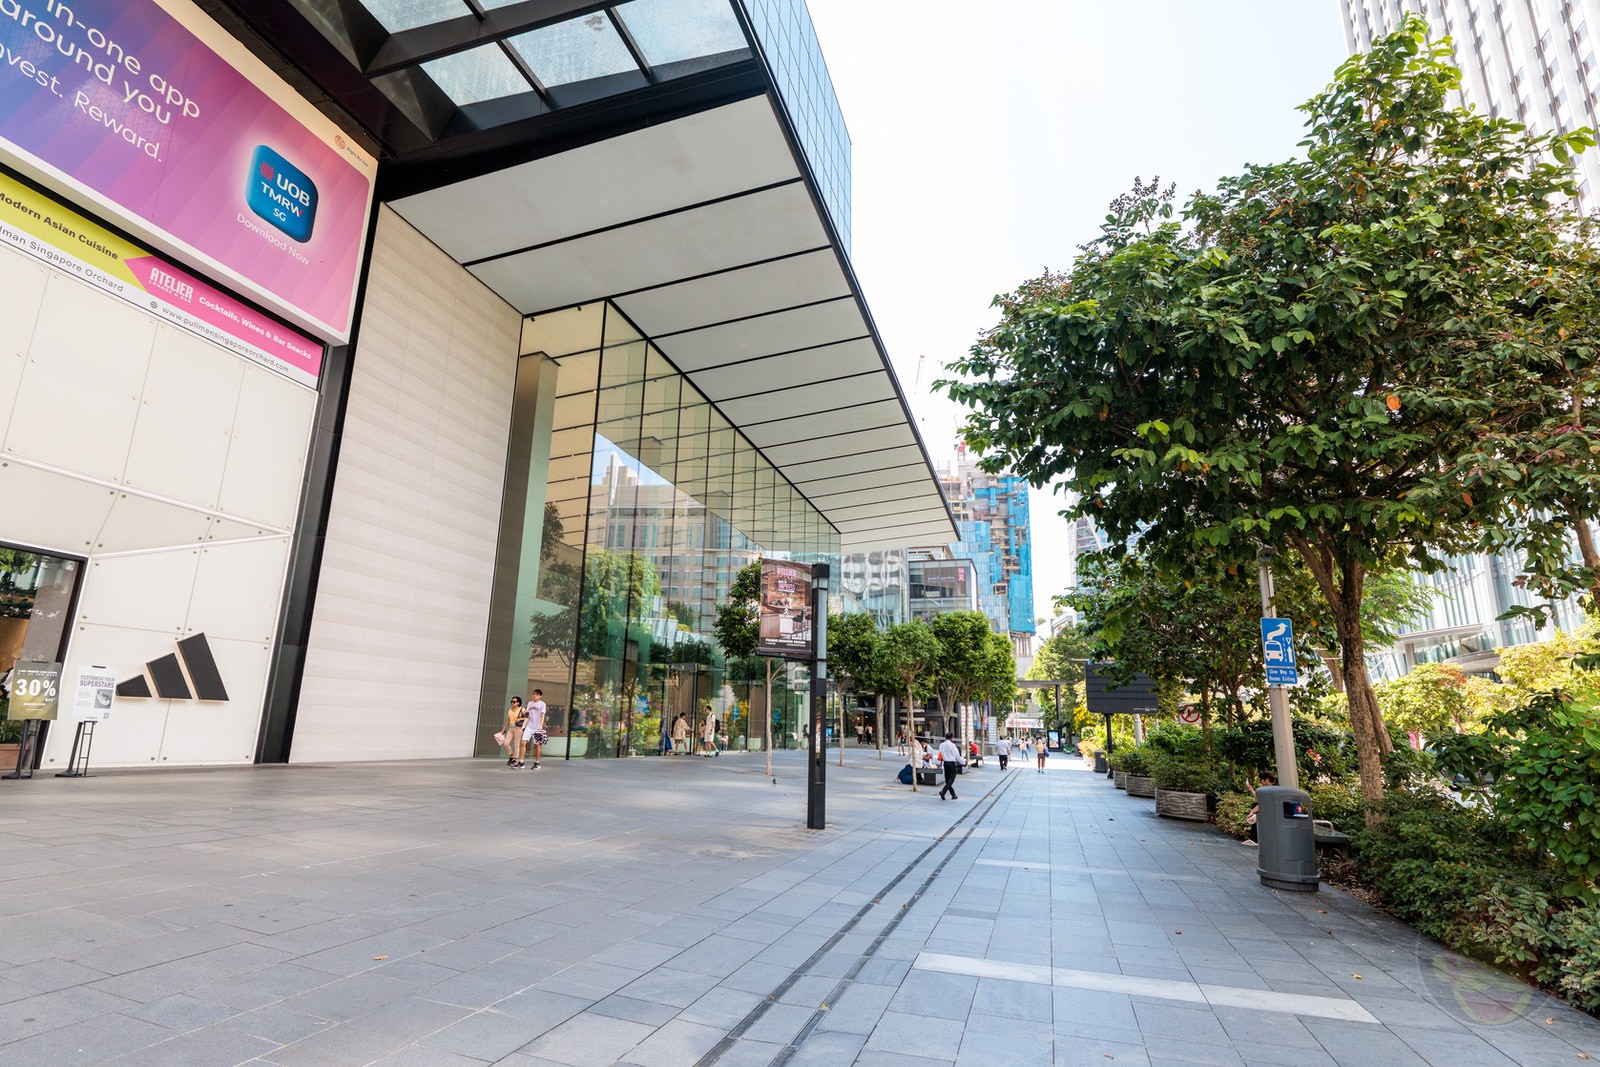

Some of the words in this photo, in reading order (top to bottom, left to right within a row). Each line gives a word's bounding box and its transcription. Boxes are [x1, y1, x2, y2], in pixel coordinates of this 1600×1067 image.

[0, 0, 116, 86] around
[123, 80, 171, 124] you
[149, 74, 200, 118] app
[74, 90, 162, 163] Reward.
[260, 181, 303, 217] TMRW
[276, 173, 311, 207] UOB
[273, 207, 286, 222] SG
[43, 216, 76, 238] Asian
[78, 234, 119, 260] Cuisine
[237, 212, 287, 251] Download
[288, 246, 310, 265] Now
[29, 241, 82, 272] Singapore
[85, 268, 124, 292] Orchard
[149, 267, 194, 300] ATELIER
[162, 307, 289, 373] www.pullmansingaporeorchard.com
[198, 296, 240, 323] Cocktails,
[241, 316, 265, 335] Wines
[265, 331, 272, 339] &
[273, 334, 286, 346] Bar
[286, 340, 312, 360] Snacks
[15, 679, 56, 696] 30%
[80, 680, 114, 688] SUPERSTARS
